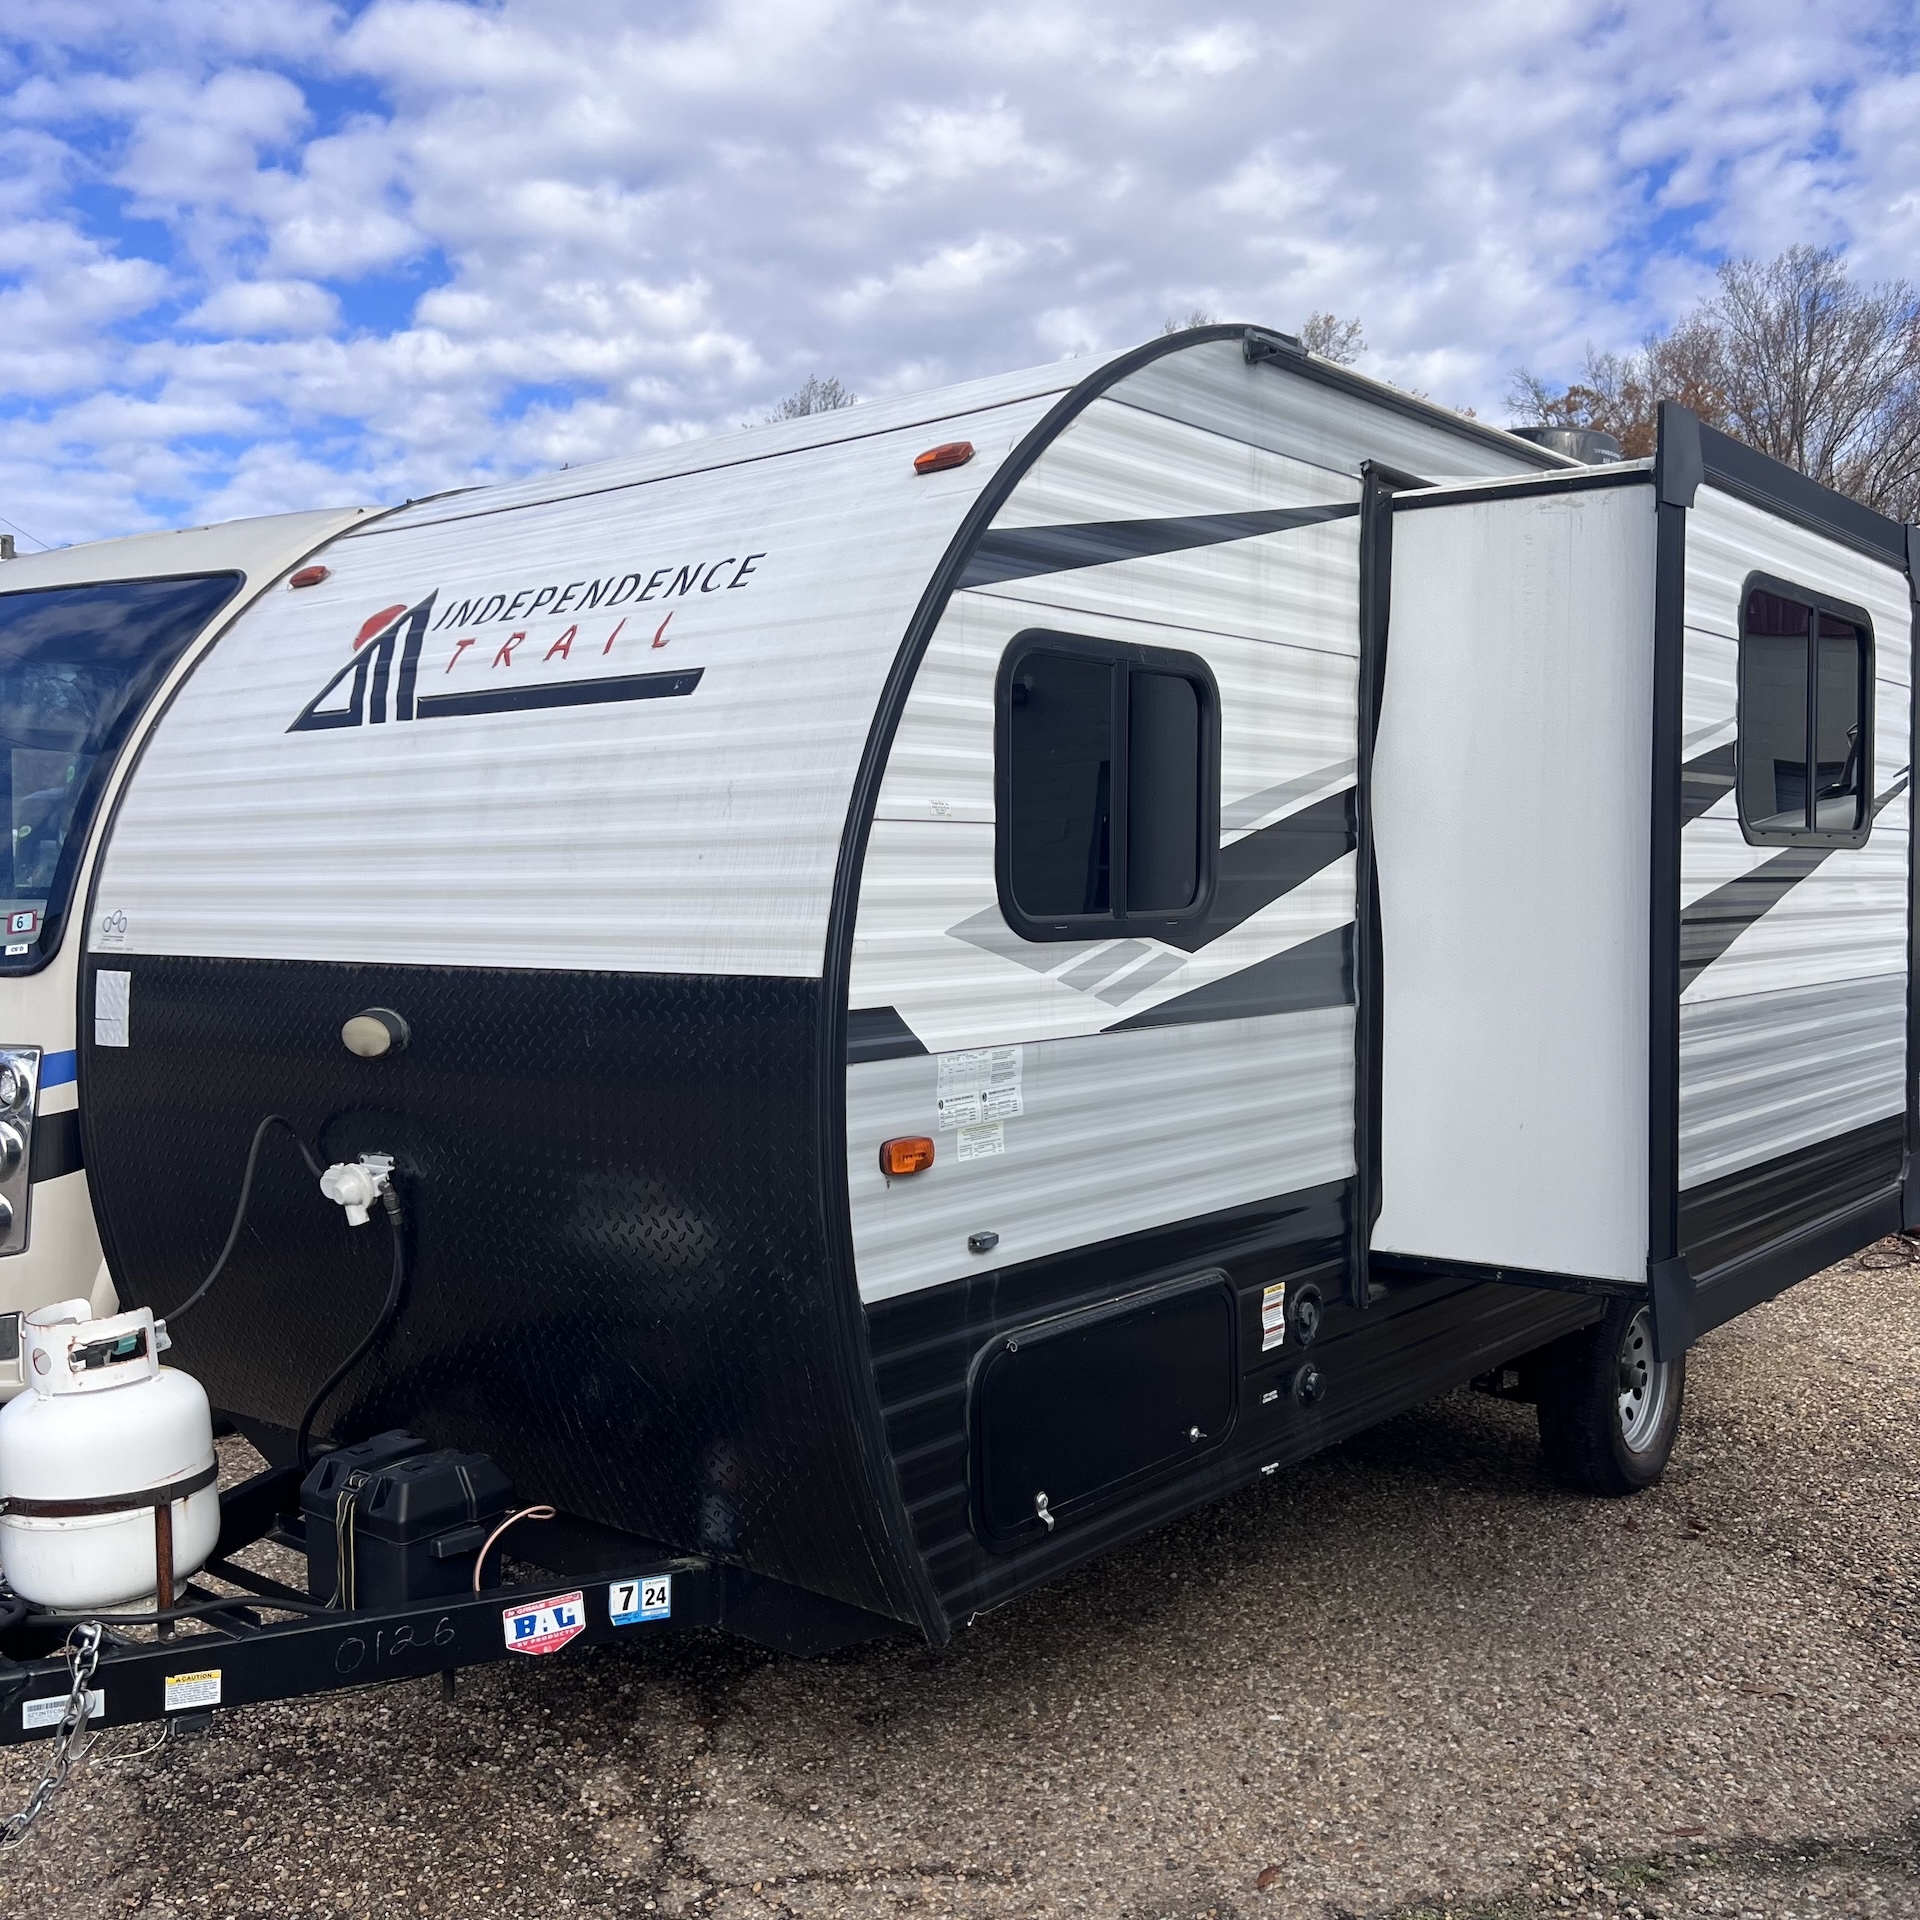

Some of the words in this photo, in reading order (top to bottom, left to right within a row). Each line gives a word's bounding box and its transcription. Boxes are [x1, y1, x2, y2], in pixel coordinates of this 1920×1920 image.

[432, 552, 767, 632] INDEPENDENCE
[445, 610, 674, 674] TRAIL
[16, 916, 24, 929] 6
[619, 1585, 634, 1611] 7
[645, 1586, 667, 1606] 24
[514, 1607, 575, 1639] BAL
[335, 1617, 455, 1673] 0126
[530, 1629, 575, 1644] PRODUCTS
[182, 1672, 213, 1682] CAUTION
